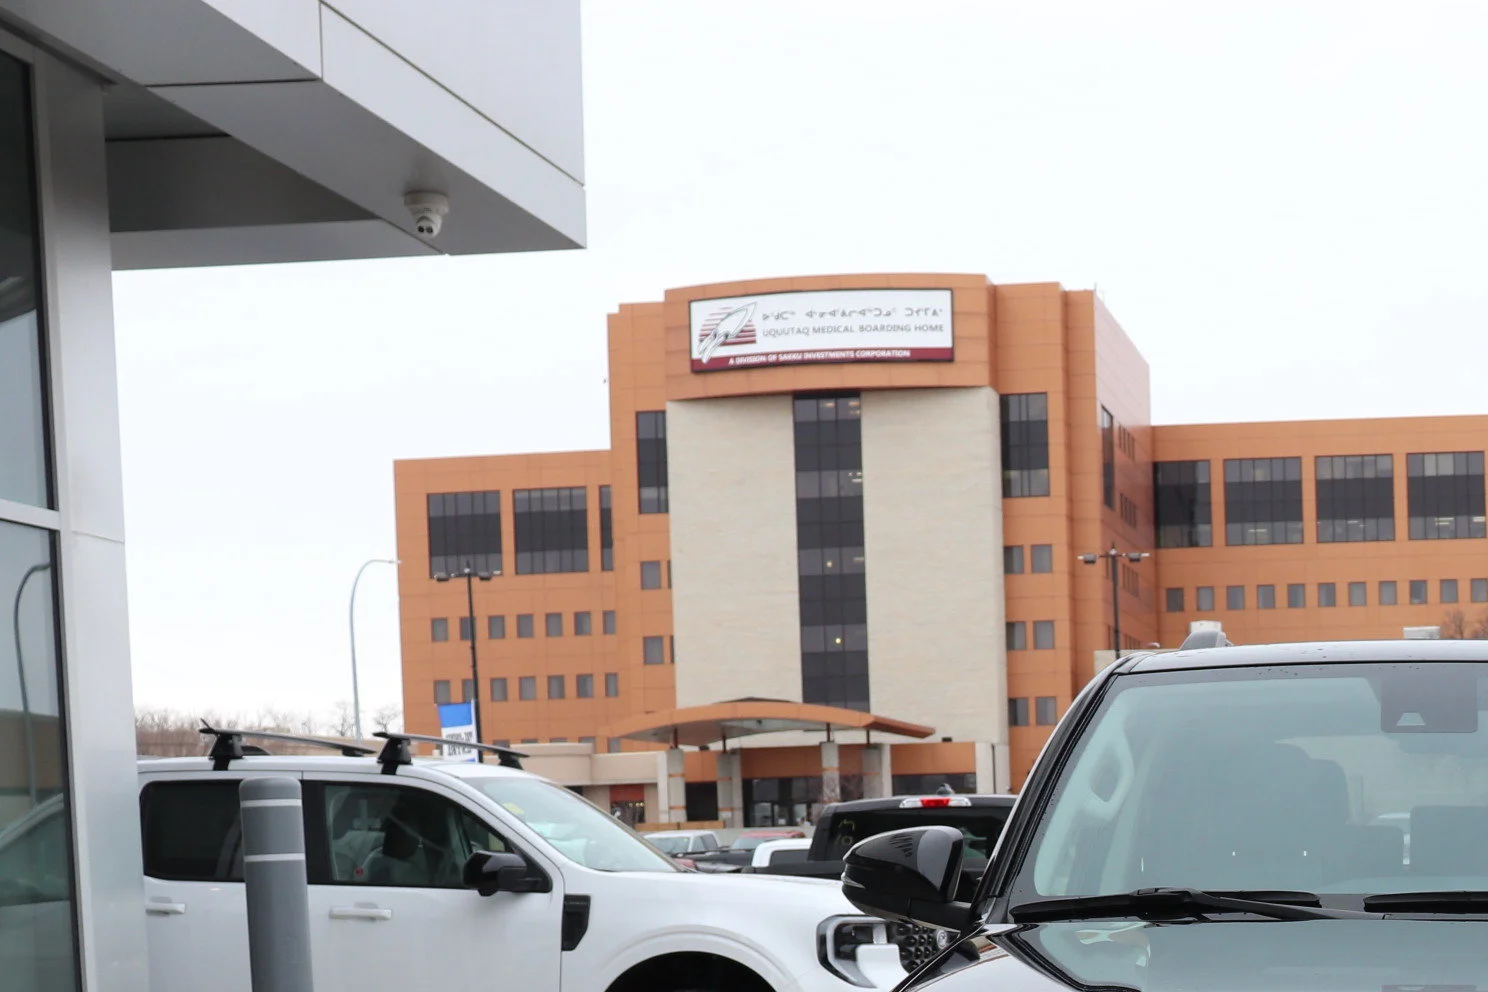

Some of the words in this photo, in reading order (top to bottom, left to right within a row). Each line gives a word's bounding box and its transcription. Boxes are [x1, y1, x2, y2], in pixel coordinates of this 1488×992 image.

[812, 325, 854, 334] MEDICAL
[859, 324, 911, 333] BOARDING
[914, 324, 944, 332] HOME
[767, 354, 778, 362] OF
[803, 351, 854, 360] INVESTMENTS
[855, 350, 911, 358] CORPORATION
